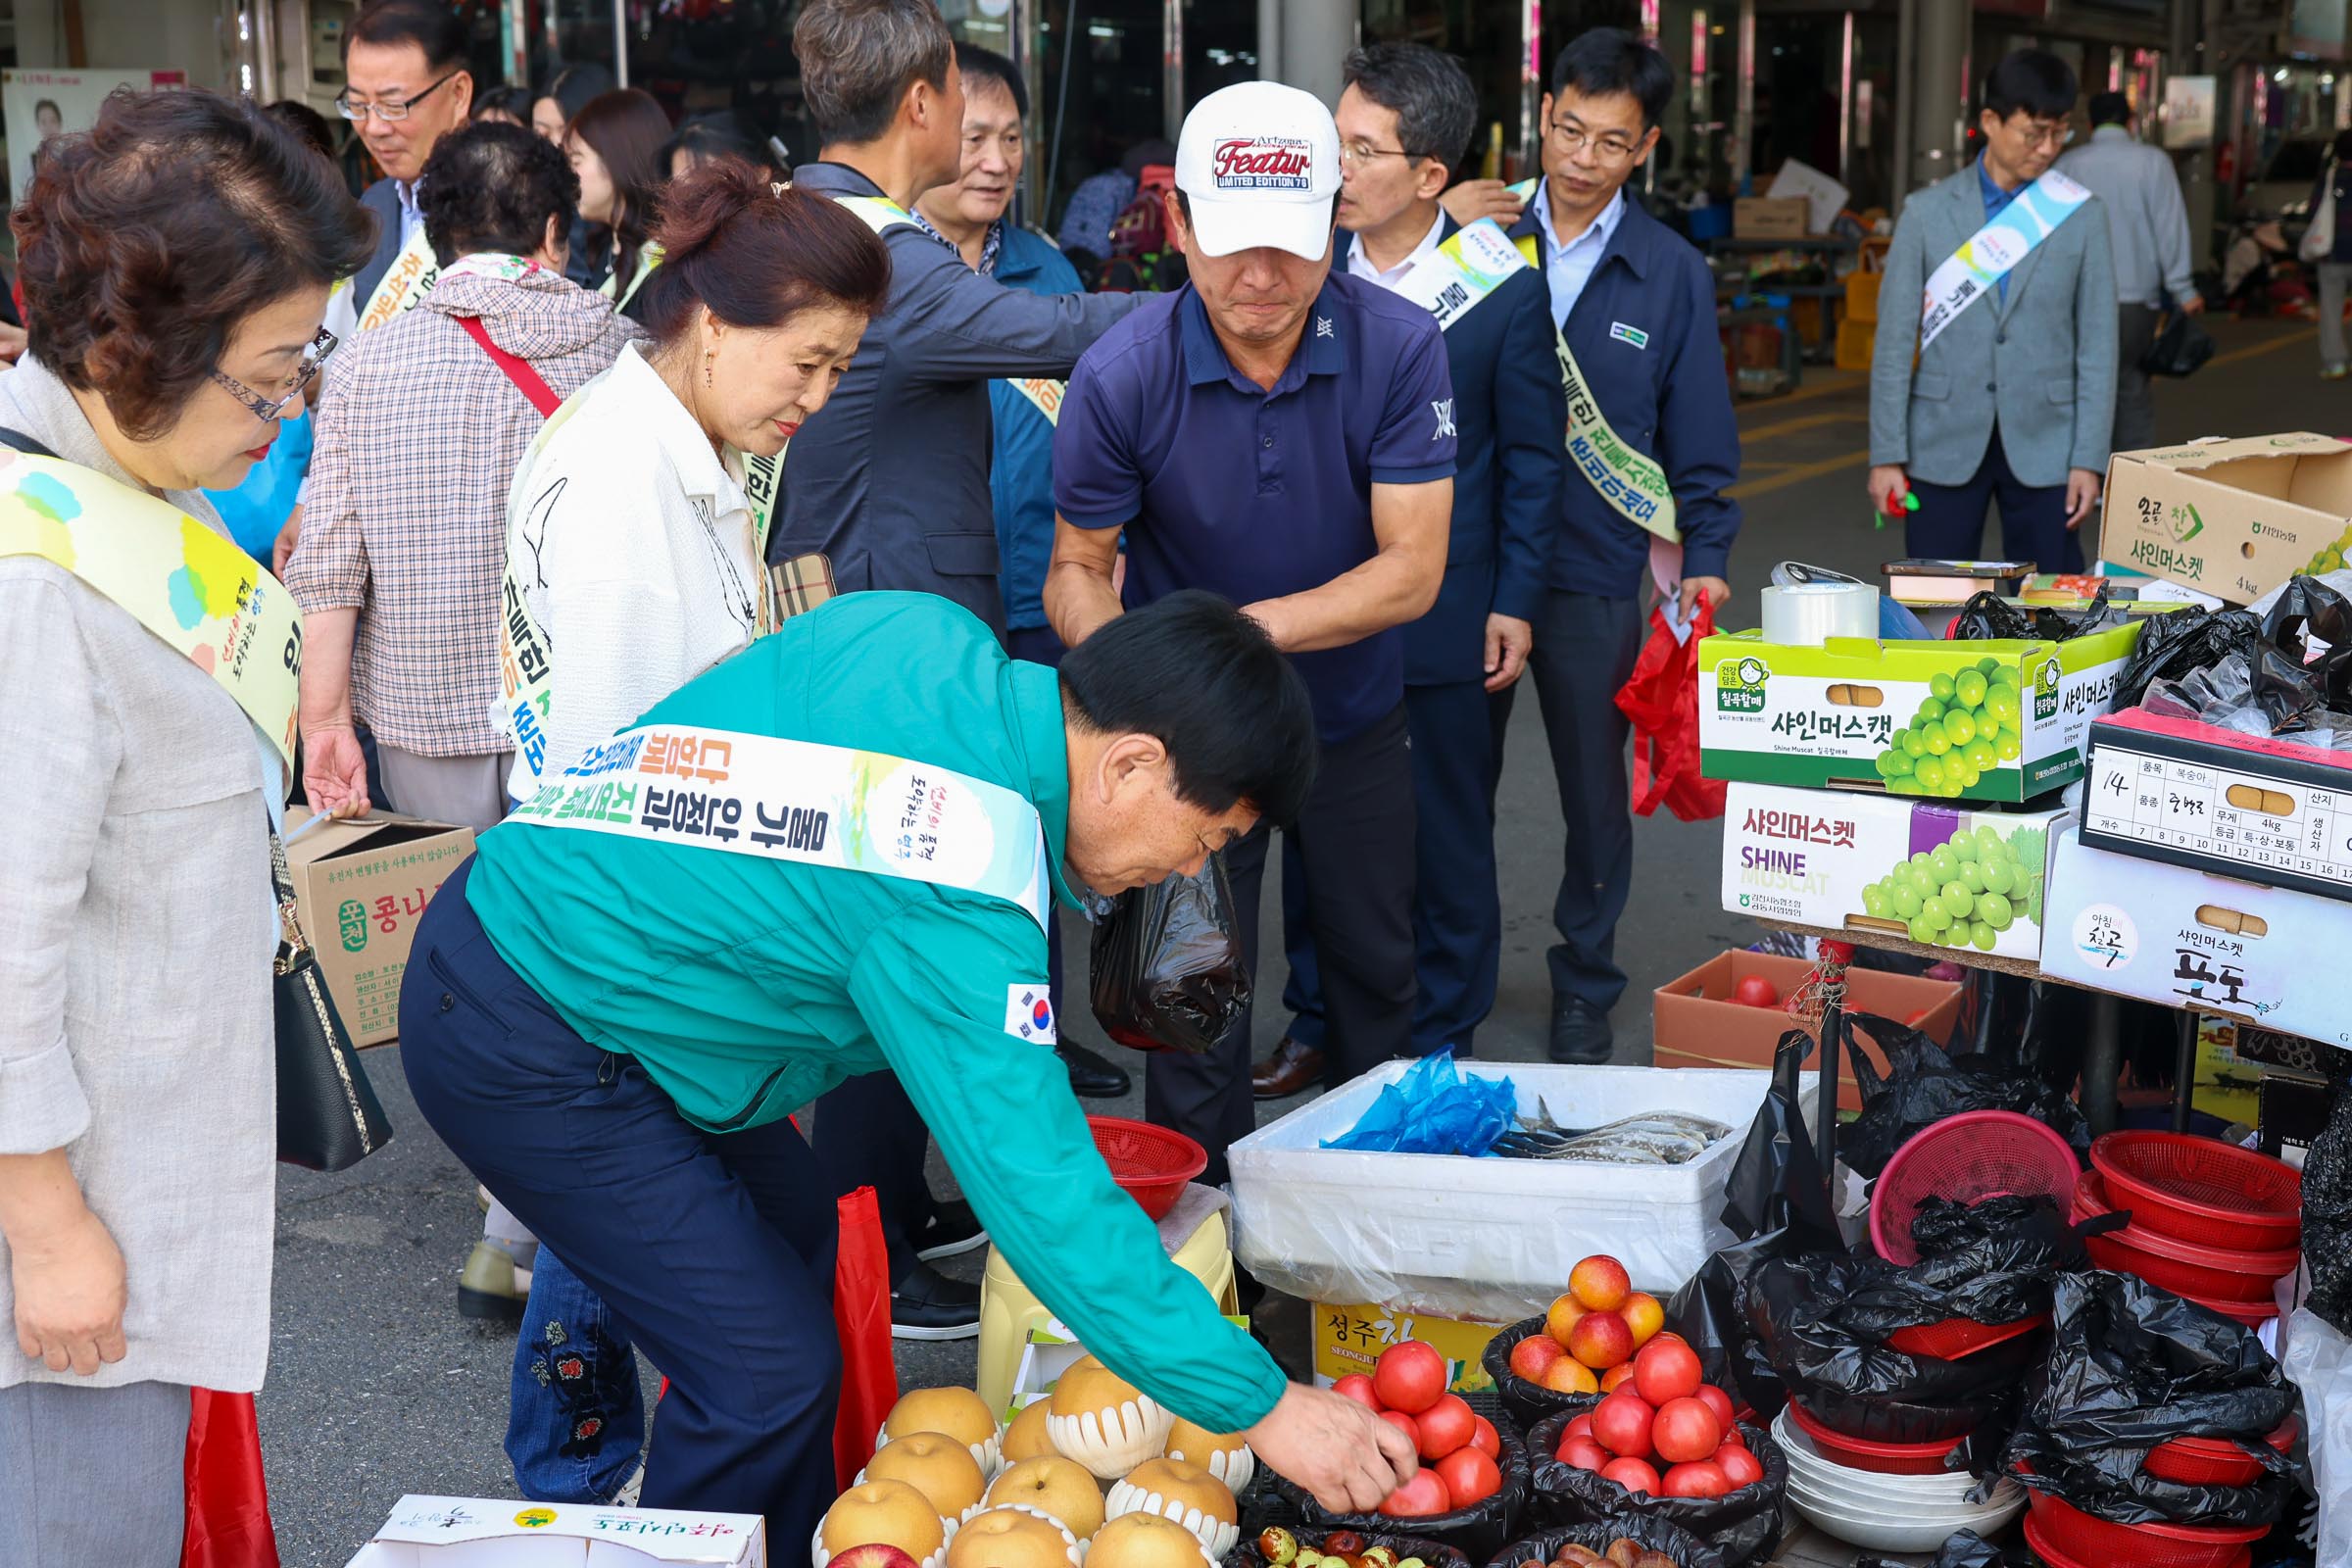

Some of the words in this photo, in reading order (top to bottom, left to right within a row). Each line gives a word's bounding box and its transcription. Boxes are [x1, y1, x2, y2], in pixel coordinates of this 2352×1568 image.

[1214, 140, 1310, 176] Featur
[1255, 176, 1294, 187] EDITION
[1570, 435, 1658, 523] 준비하세요
[2131, 539, 2203, 581] 샤인머스켓
[504, 574, 550, 685] 가득한
[1722, 665, 1737, 676] 건강
[1722, 676, 1737, 686] 담은
[1721, 691, 1762, 708] 칠곡할매
[1771, 710, 1892, 745] 샤인머스캣
[639, 732, 732, 785] 다함께
[2142, 761, 2162, 774] 품목
[2103, 770, 2129, 797] 14
[2178, 768, 2206, 783] 복숭아
[641, 785, 742, 843] 안정과
[901, 774, 926, 828] 도약하는
[930, 785, 948, 829] 선비의
[2139, 795, 2159, 808] 품종
[2311, 793, 2331, 806] 산지
[751, 802, 828, 851] 물가
[1742, 808, 1855, 849] 샤인머스켓
[2100, 819, 2119, 831] 개수
[2217, 810, 2237, 824] 무게
[2261, 818, 2281, 832] 4kg
[894, 834, 911, 860] 영주
[916, 833, 937, 861] 품격
[2215, 826, 2235, 840] 등급
[2310, 816, 2324, 852] 생산자
[328, 868, 354, 883] 유전자
[392, 852, 424, 869] 사용하지
[427, 845, 460, 862] 않습니다
[1741, 846, 1806, 877] SHINE
[2139, 827, 2145, 836] 7
[2159, 831, 2165, 840] 8
[2197, 839, 2208, 849] 10
[2217, 844, 2228, 853] 11
[2237, 848, 2249, 858] 12
[2258, 852, 2270, 861] 13
[2278, 856, 2290, 866] 14
[2300, 860, 2312, 870] 15
[2321, 864, 2333, 874] 16
[1740, 866, 1830, 896] MUSCAT
[340, 901, 366, 948] 포천
[372, 884, 441, 934] 콩나
[2177, 929, 2243, 957] 샤인머스켓
[2173, 948, 2258, 1005] 포도
[1328, 1313, 1376, 1348] 성주
[1331, 1346, 1373, 1364] SEONGJU
